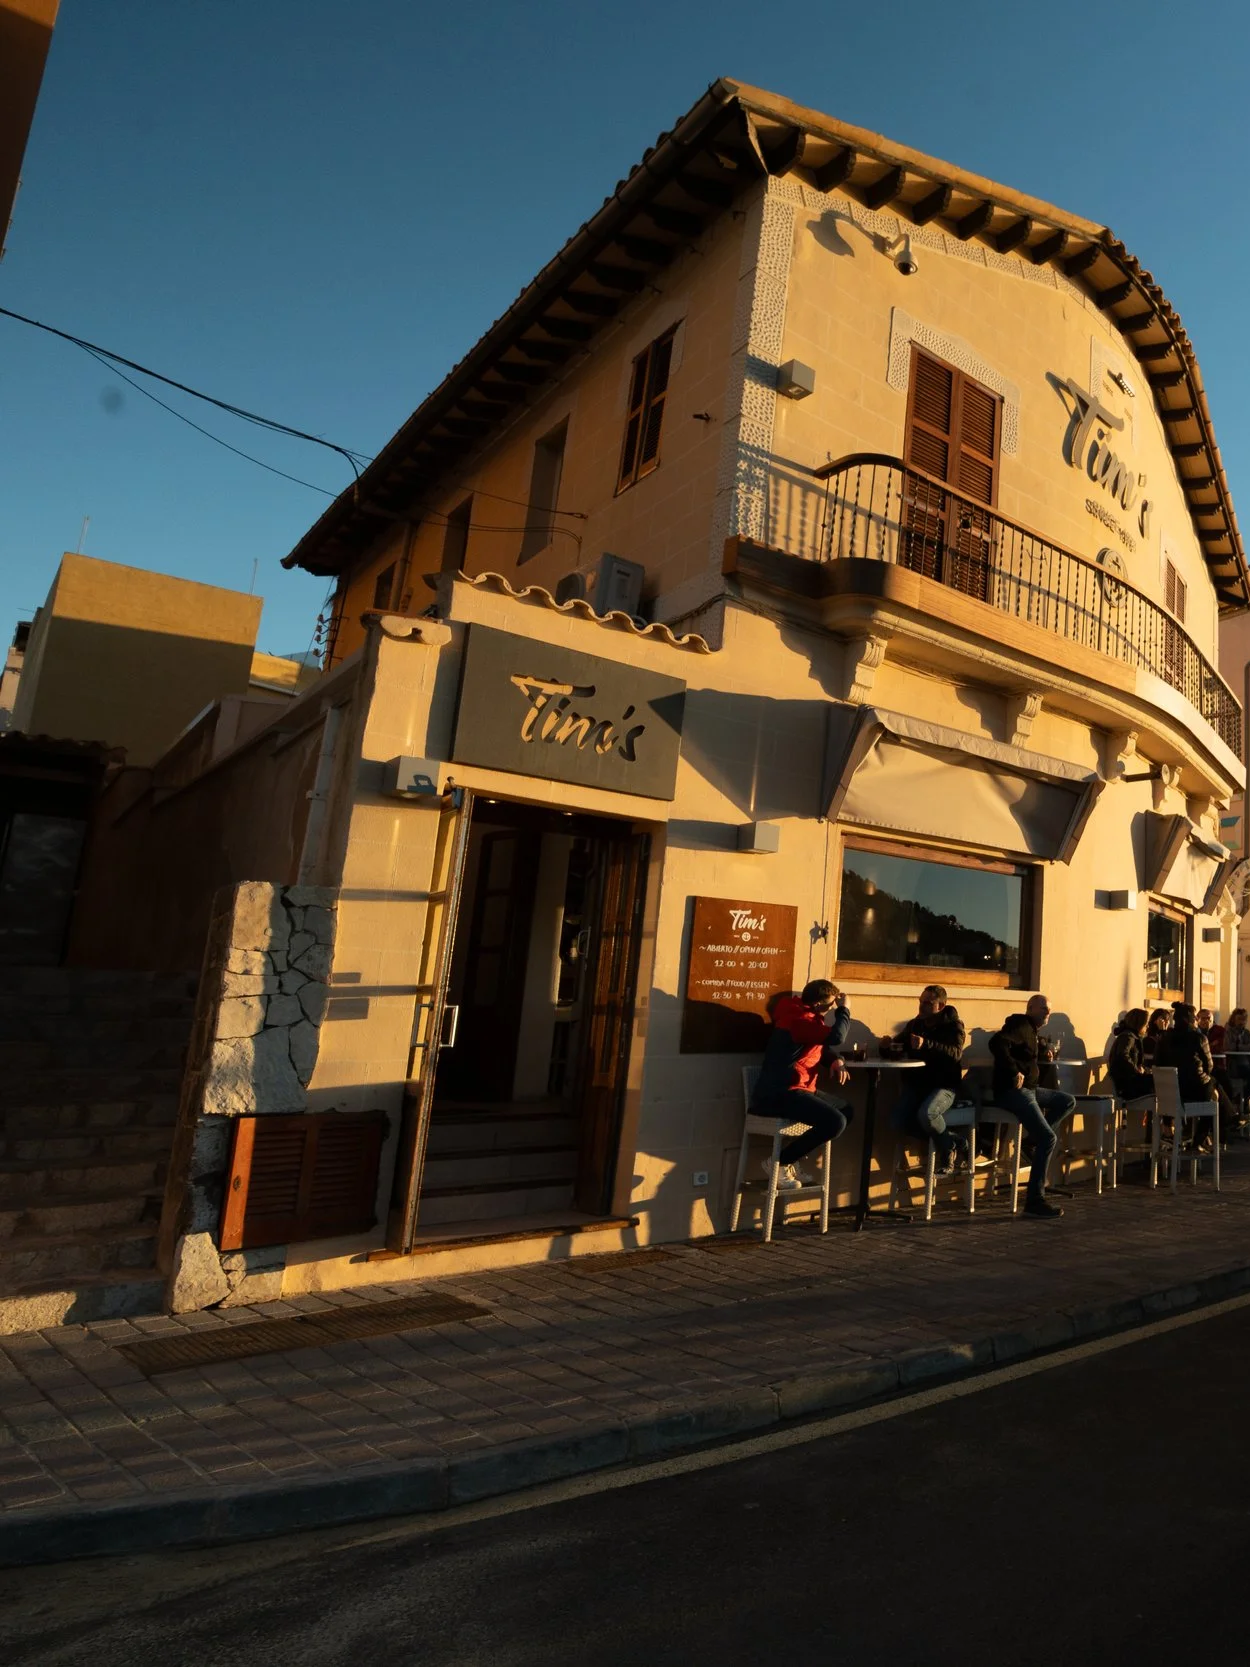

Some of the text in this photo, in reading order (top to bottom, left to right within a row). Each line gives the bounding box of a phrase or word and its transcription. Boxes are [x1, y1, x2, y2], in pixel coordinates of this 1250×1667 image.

[510, 673, 646, 762] Tim's
[729, 909, 767, 931] Tim's
[706, 944, 733, 953] ABIERTO
[739, 945, 756, 953] OPEN
[761, 947, 779, 955] OFFEN
[714, 959, 768, 969] 12:00 20:00
[701, 979, 725, 987] COMIDA
[731, 979, 745, 987] FOOD
[750, 981, 770, 989] ESSEN
